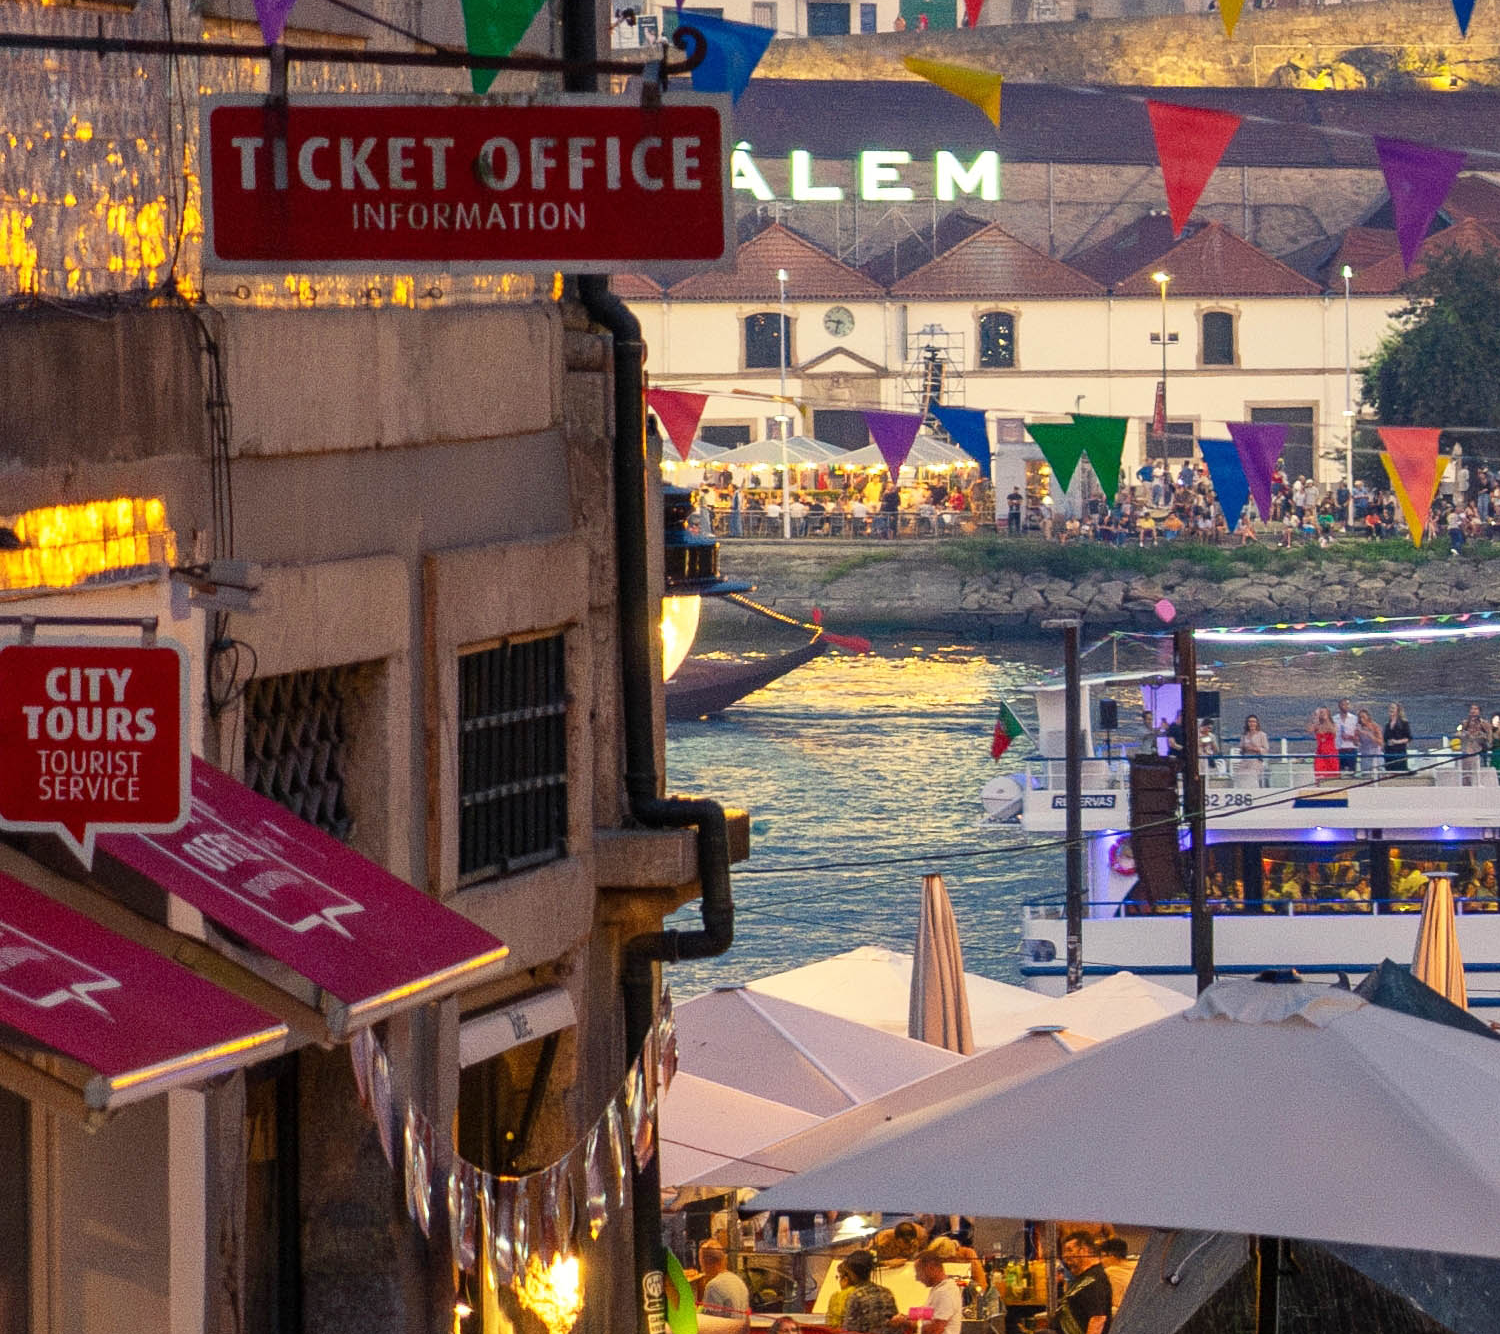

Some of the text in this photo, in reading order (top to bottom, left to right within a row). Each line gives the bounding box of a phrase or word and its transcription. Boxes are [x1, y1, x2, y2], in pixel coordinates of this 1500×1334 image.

[231, 135, 702, 193] TICKET OFFICE
[351, 202, 587, 232] INFORMATION
[45, 667, 133, 702] CITY
[22, 706, 156, 742] TOURS
[37, 750, 142, 776] TOURIST
[38, 776, 140, 802] SERVICE
[1055, 795, 1116, 808] REERVAS
